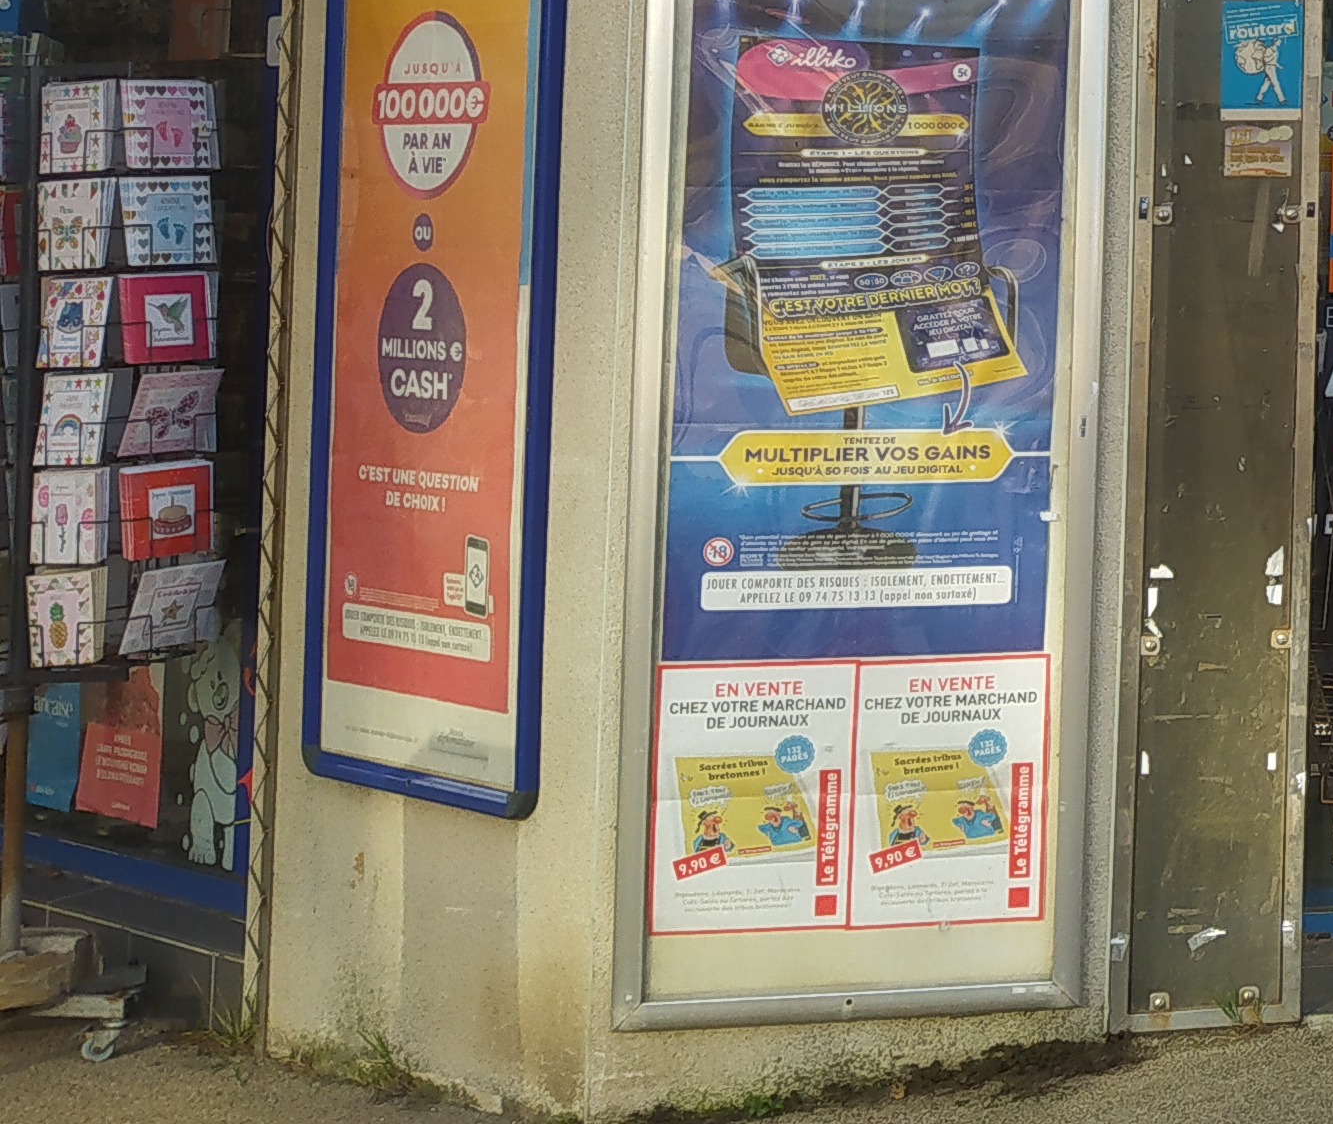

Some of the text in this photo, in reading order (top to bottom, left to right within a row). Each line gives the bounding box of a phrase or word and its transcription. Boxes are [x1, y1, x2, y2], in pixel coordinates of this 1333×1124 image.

[1229, 20, 1296, 41] routard
[403, 133, 451, 149] PAR AN
[869, 285, 935, 305] DERNIER
[413, 279, 433, 330] 2
[382, 337, 446, 362] MILLIONS
[844, 437, 879, 445] TENTEZ
[745, 445, 991, 463] MULTIPLIER VOS GAINS
[892, 464, 962, 474] JEU DIGITAL
[393, 467, 479, 494] UNE QUESTION
[706, 576, 859, 590] JOUER COMPORTE RISQUES
[740, 590, 781, 604] APPELEZ
[715, 681, 803, 698] EN VENTE
[910, 676, 995, 692] EN VENTE
[670, 697, 846, 715] CHEZ VOTRE MARCHAND
[865, 691, 1037, 711] CHEZ VOTRE MARCHAND
[706, 713, 809, 729] DE JOURNAUX
[901, 708, 1001, 724] DE JOURNAUX
[699, 761, 737, 771] Sacrées
[894, 756, 931, 766] Sacrées
[708, 770, 760, 781] bretonnes
[903, 764, 954, 775] bretonnes
[822, 772, 838, 864] Télégramme
[1014, 766, 1030, 856] Télégramme
